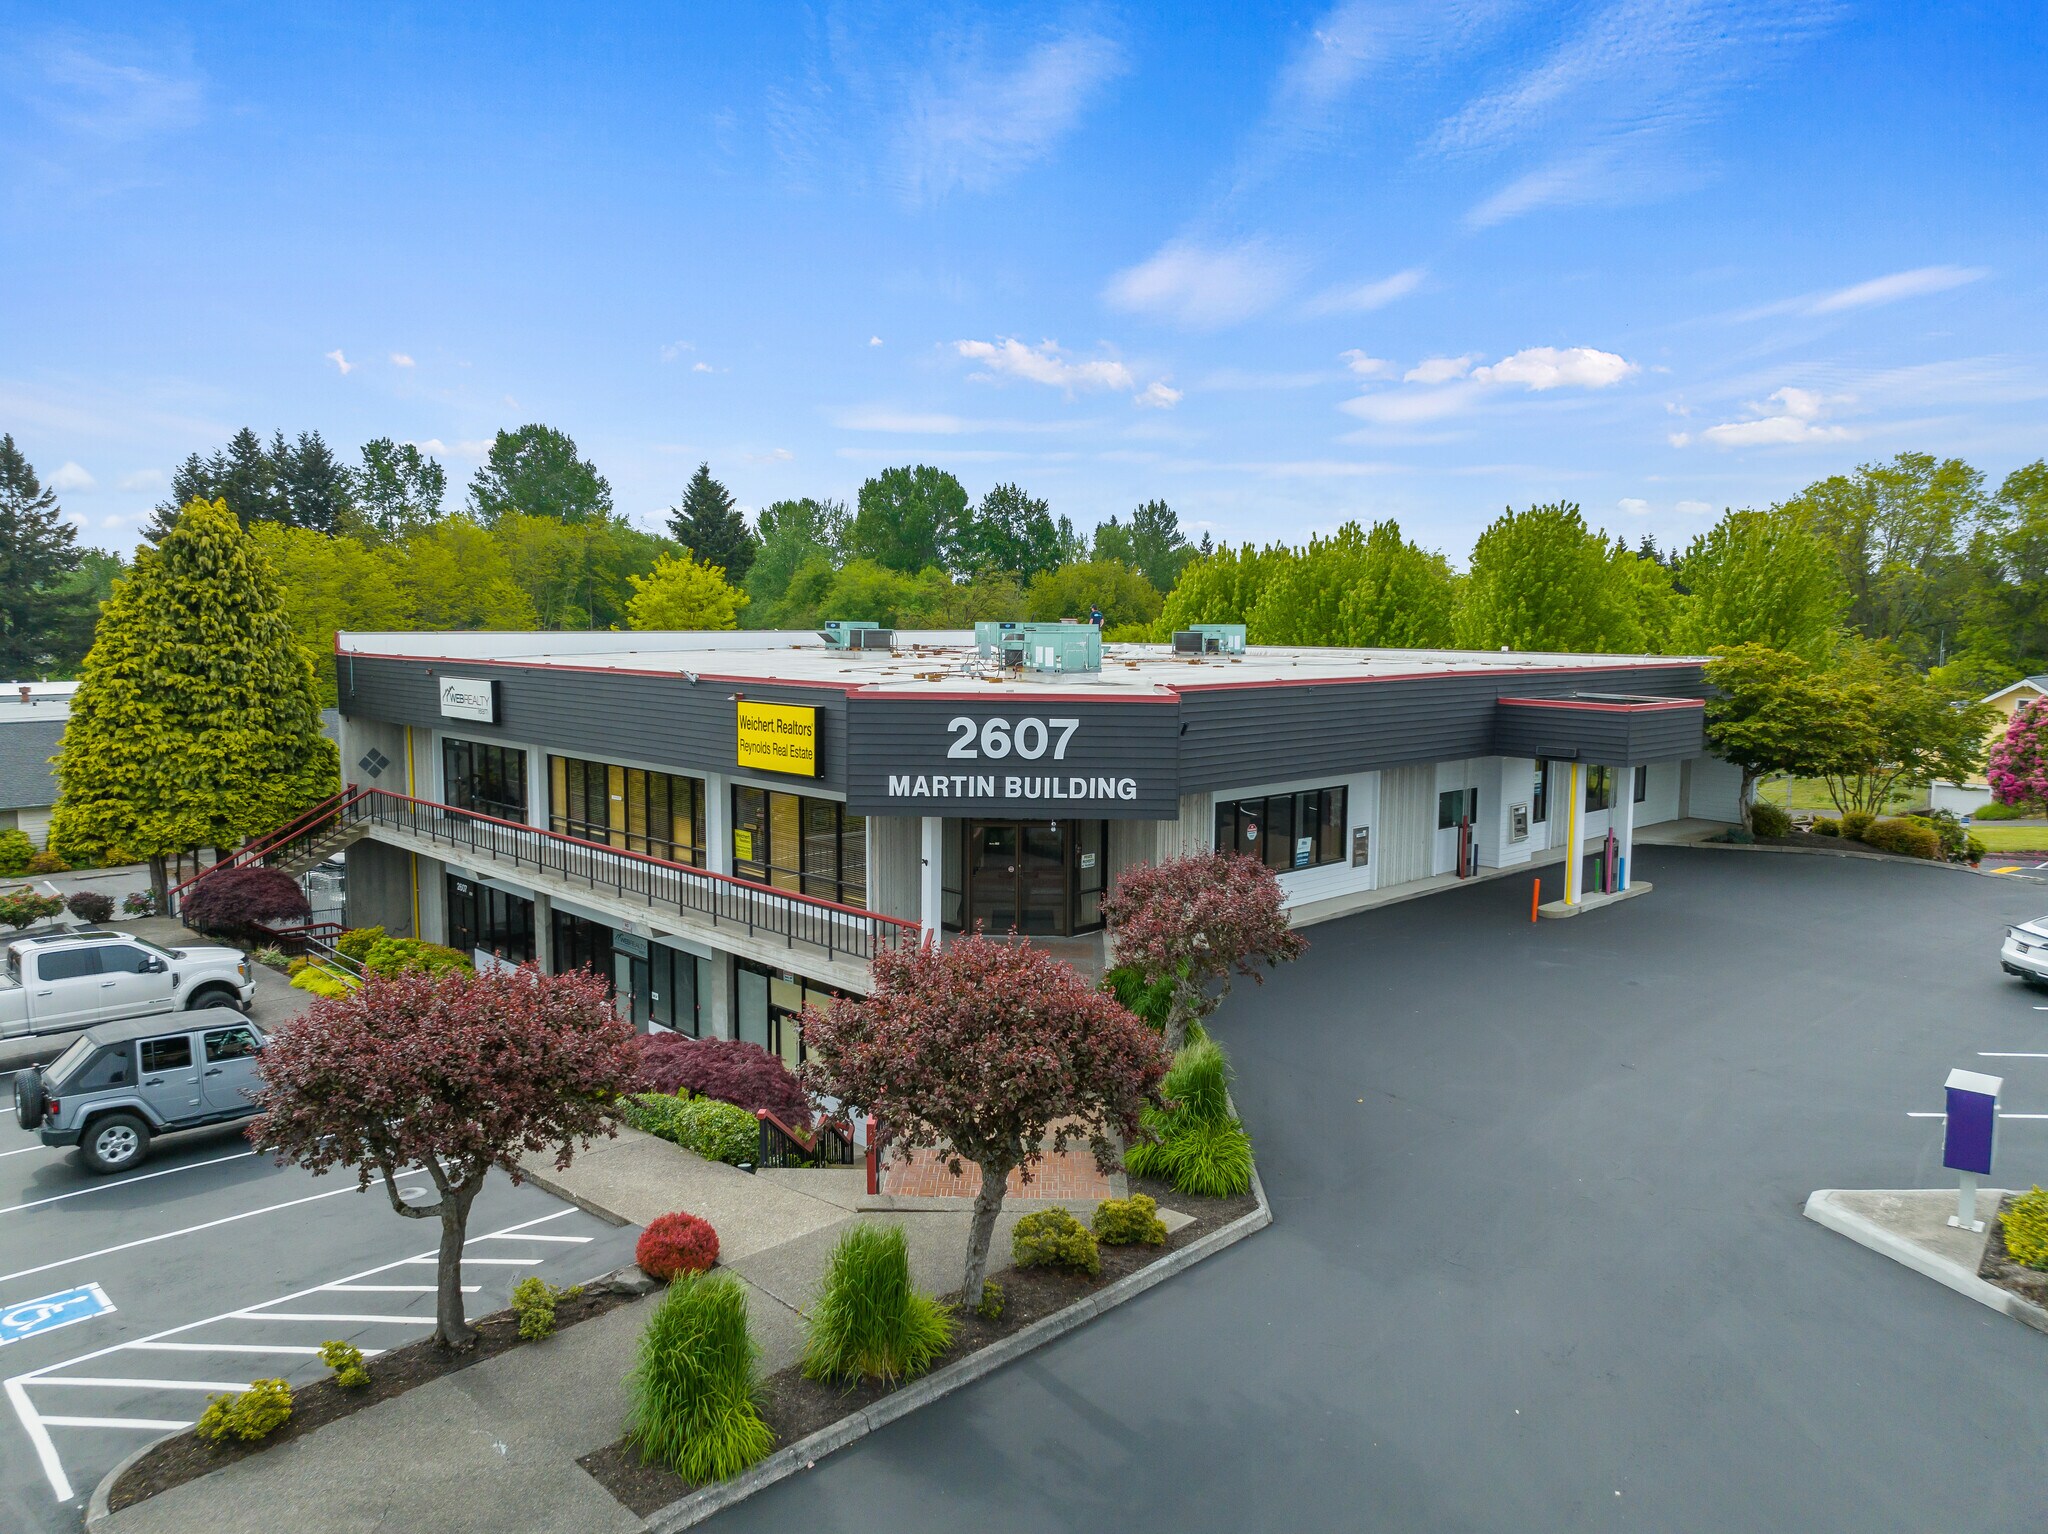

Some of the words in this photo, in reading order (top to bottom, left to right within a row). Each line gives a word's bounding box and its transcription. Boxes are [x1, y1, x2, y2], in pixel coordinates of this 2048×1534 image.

[739, 715, 775, 733] Weichert
[776, 718, 812, 737] Realtors
[740, 738, 771, 755] Reynolds
[772, 742, 788, 757] Real
[789, 744, 813, 760] Estate
[947, 717, 1079, 760] 2607
[888, 775, 995, 797] MARTIN
[1005, 776, 1137, 800] BUILDING
